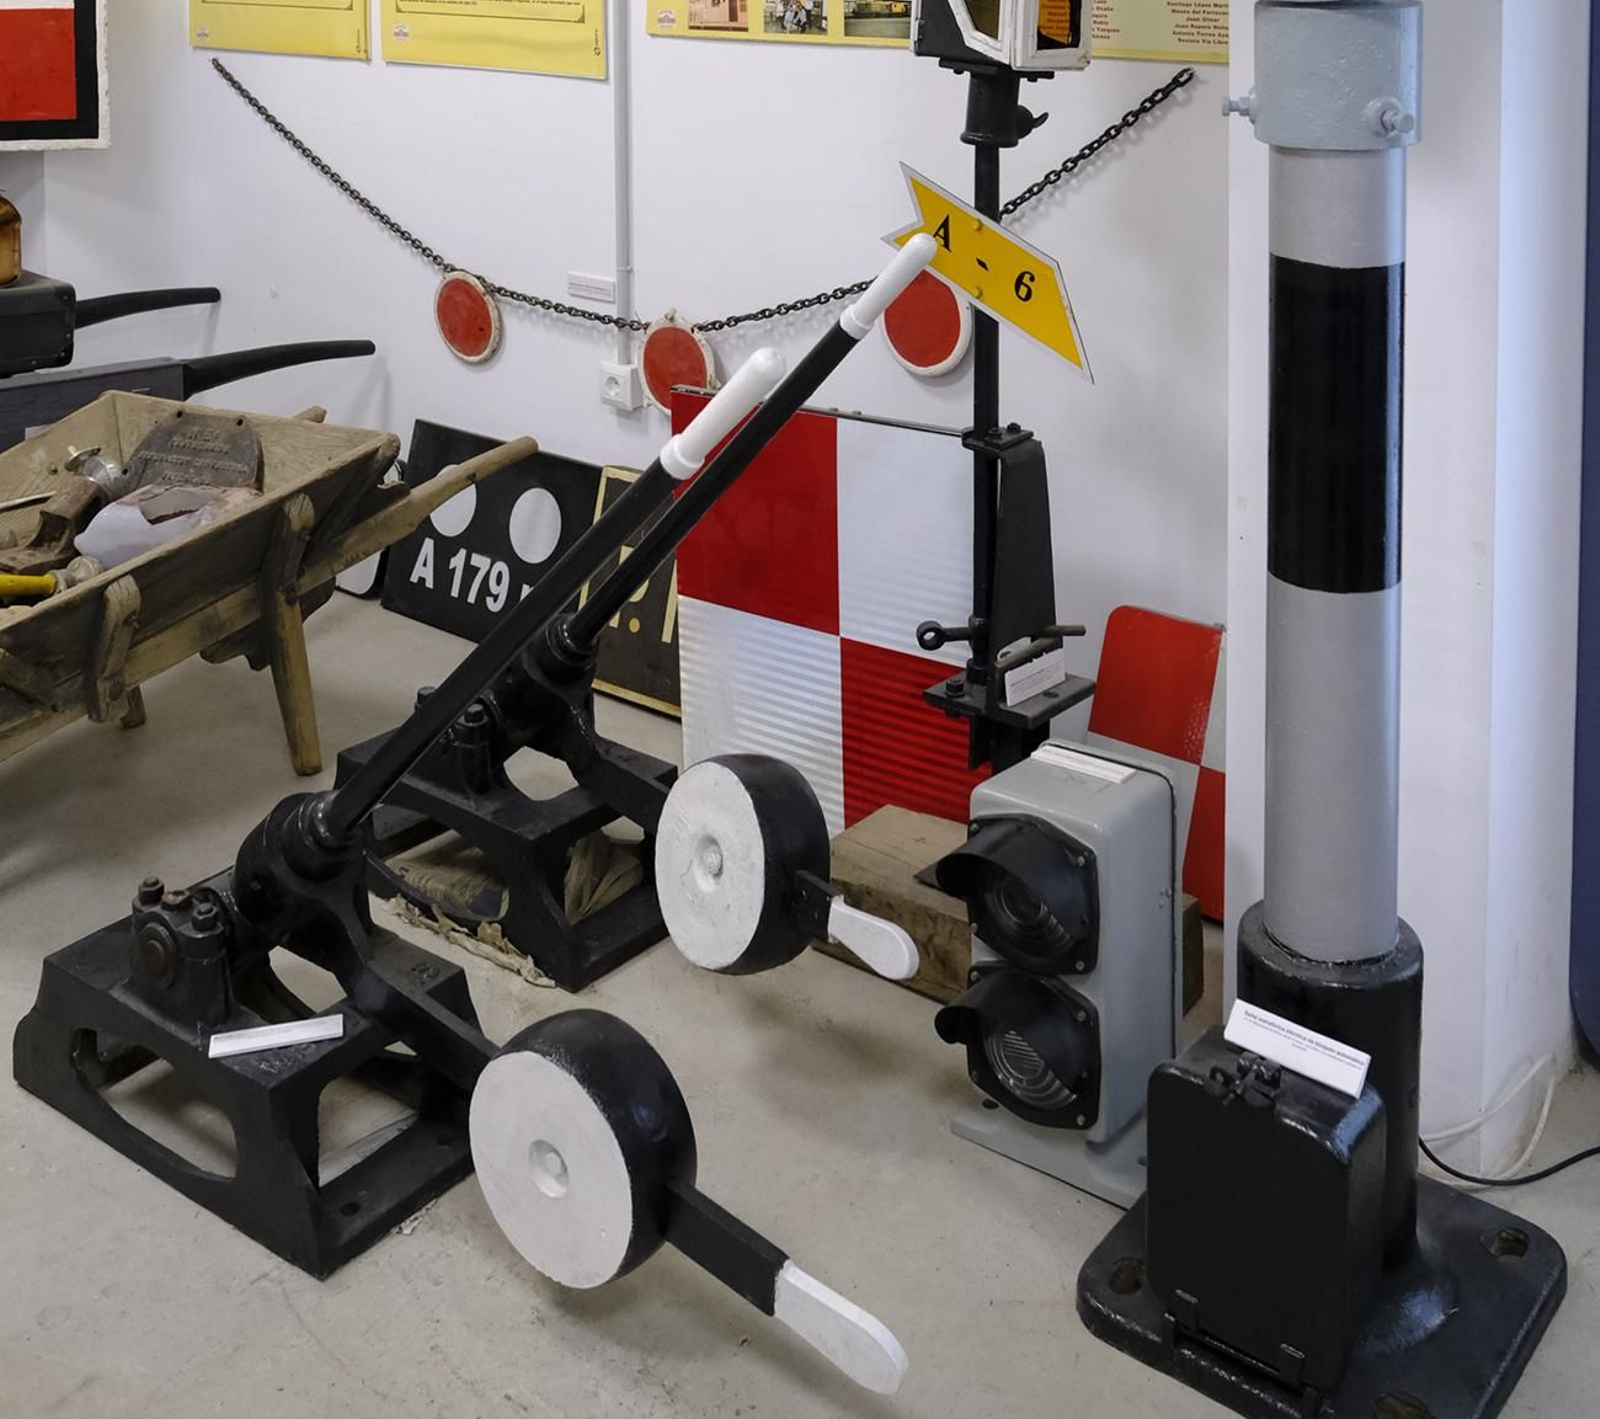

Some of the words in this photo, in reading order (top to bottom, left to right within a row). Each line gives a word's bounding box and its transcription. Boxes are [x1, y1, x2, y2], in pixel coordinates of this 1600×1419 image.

[933, 214, 952, 253] A
[1014, 270, 1035, 302] 6
[409, 537, 435, 590] A
[449, 548, 510, 613] 179
